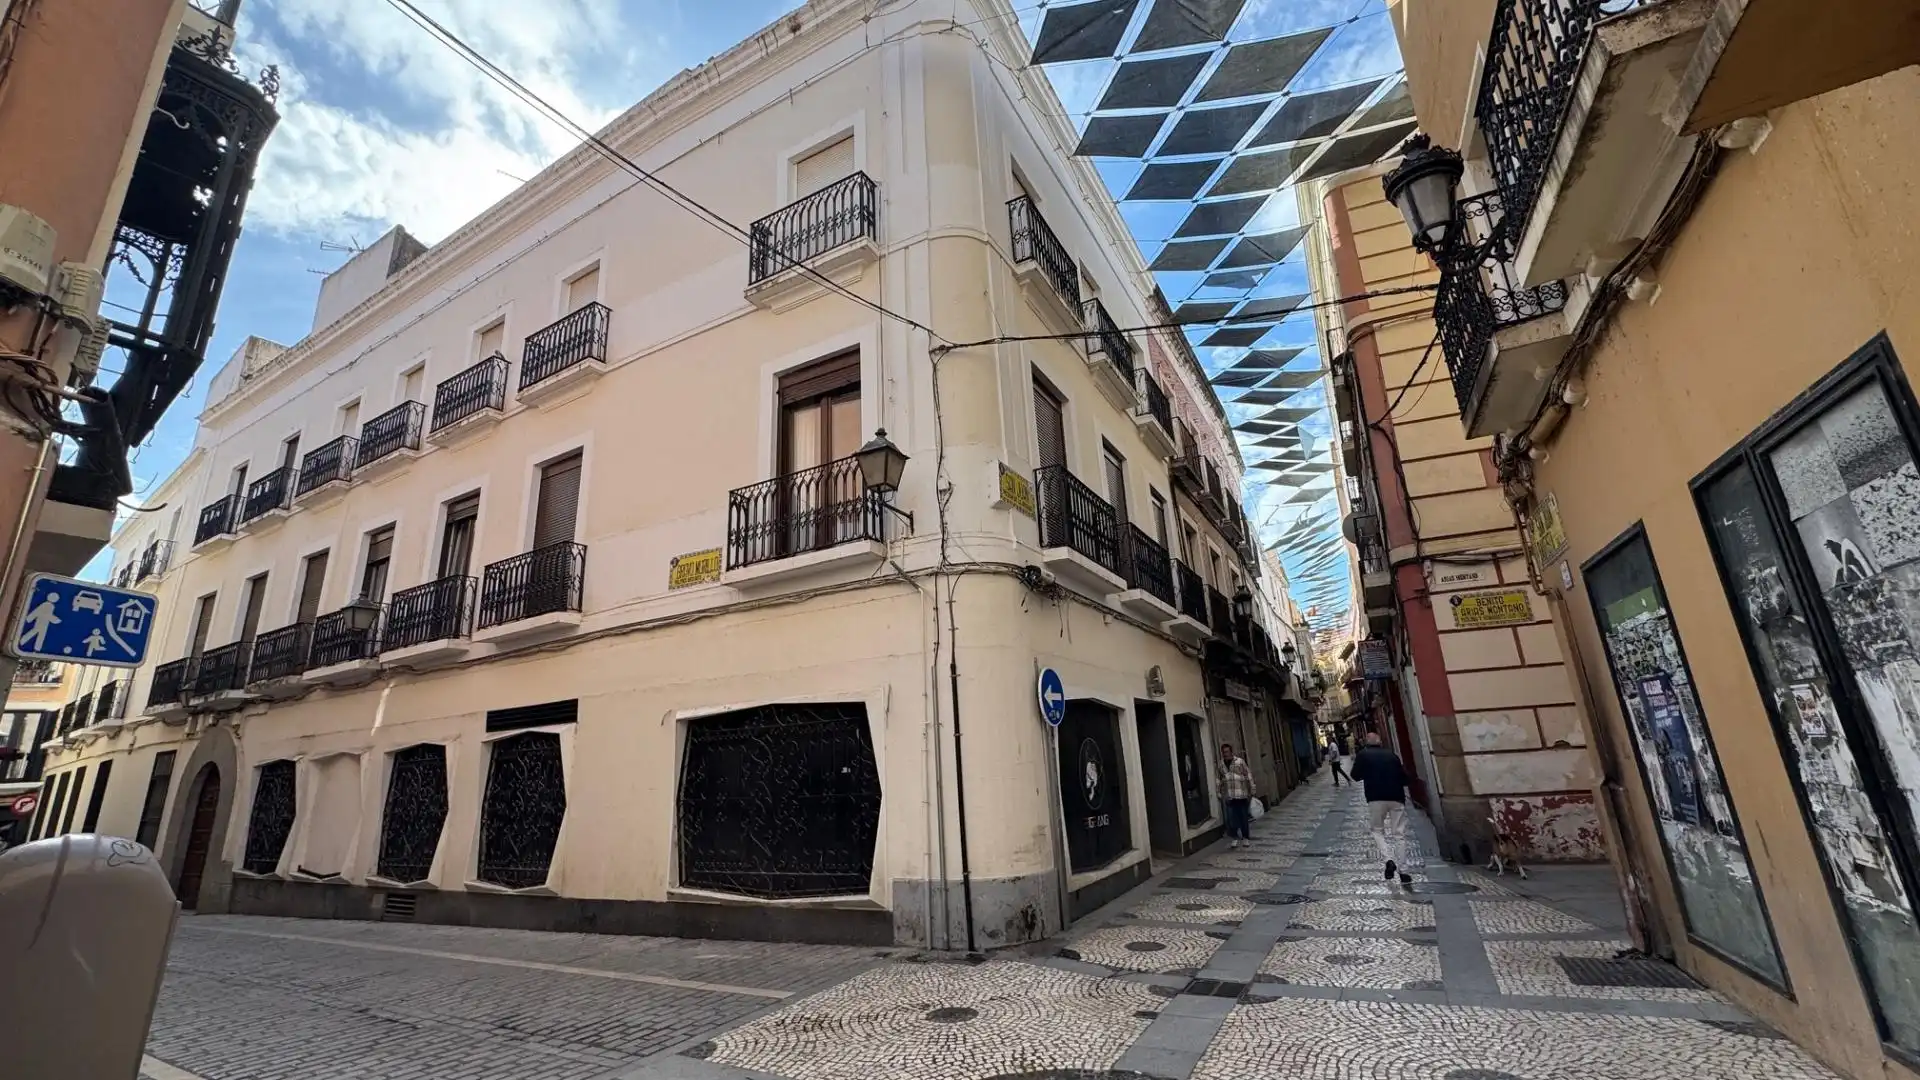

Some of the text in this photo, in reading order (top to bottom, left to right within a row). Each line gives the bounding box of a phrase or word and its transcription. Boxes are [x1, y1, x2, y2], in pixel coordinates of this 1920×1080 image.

[1441, 573, 1479, 583] ARIAS MONTANO
[1476, 596, 1505, 607] BENITO
[1461, 603, 1524, 616] ARIAS MONTANO
